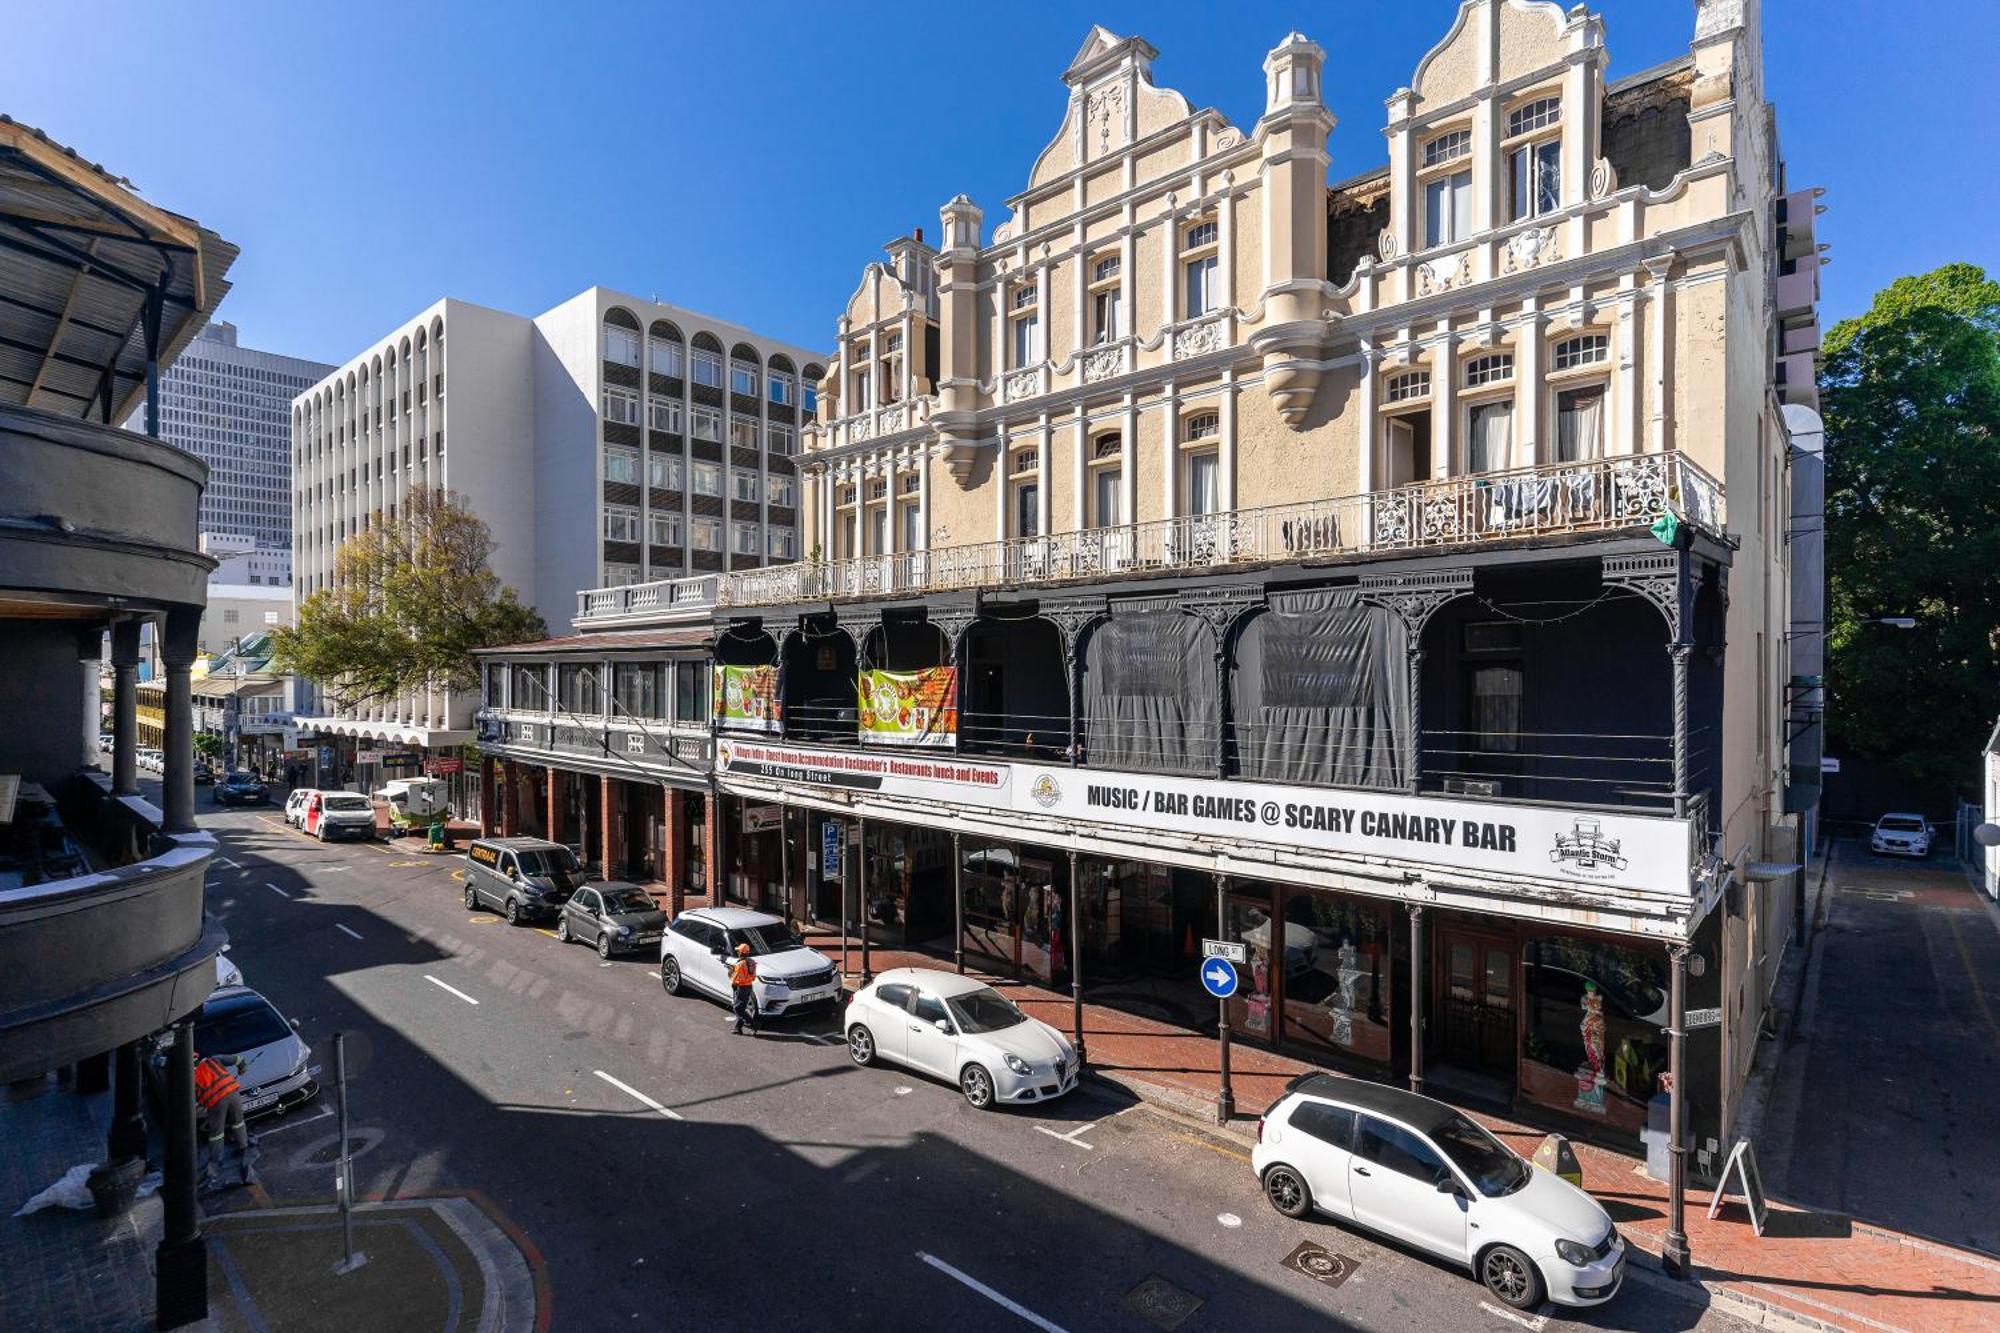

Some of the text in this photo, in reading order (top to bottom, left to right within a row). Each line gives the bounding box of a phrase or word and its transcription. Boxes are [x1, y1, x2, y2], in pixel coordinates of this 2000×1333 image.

[798, 752, 844, 768] Accommodation
[845, 756, 887, 772] Backpacker's
[889, 760, 933, 777] Restaurants
[934, 764, 954, 780] lunch
[956, 767, 970, 781] and
[972, 768, 998, 785] Events
[806, 770, 832, 782] Street
[1087, 785, 1138, 810] MUSIC
[1142, 790, 1150, 811] /
[1154, 792, 1188, 815] BAR
[1193, 795, 1256, 823] GAMES
[1260, 801, 1281, 826] @
[1285, 804, 1355, 834] SCARY
[1361, 811, 1456, 846] CANARY
[1462, 820, 1516, 852] BAR
[1560, 849, 1616, 863] Atlantic Storm
[1209, 944, 1229, 957] LONG
